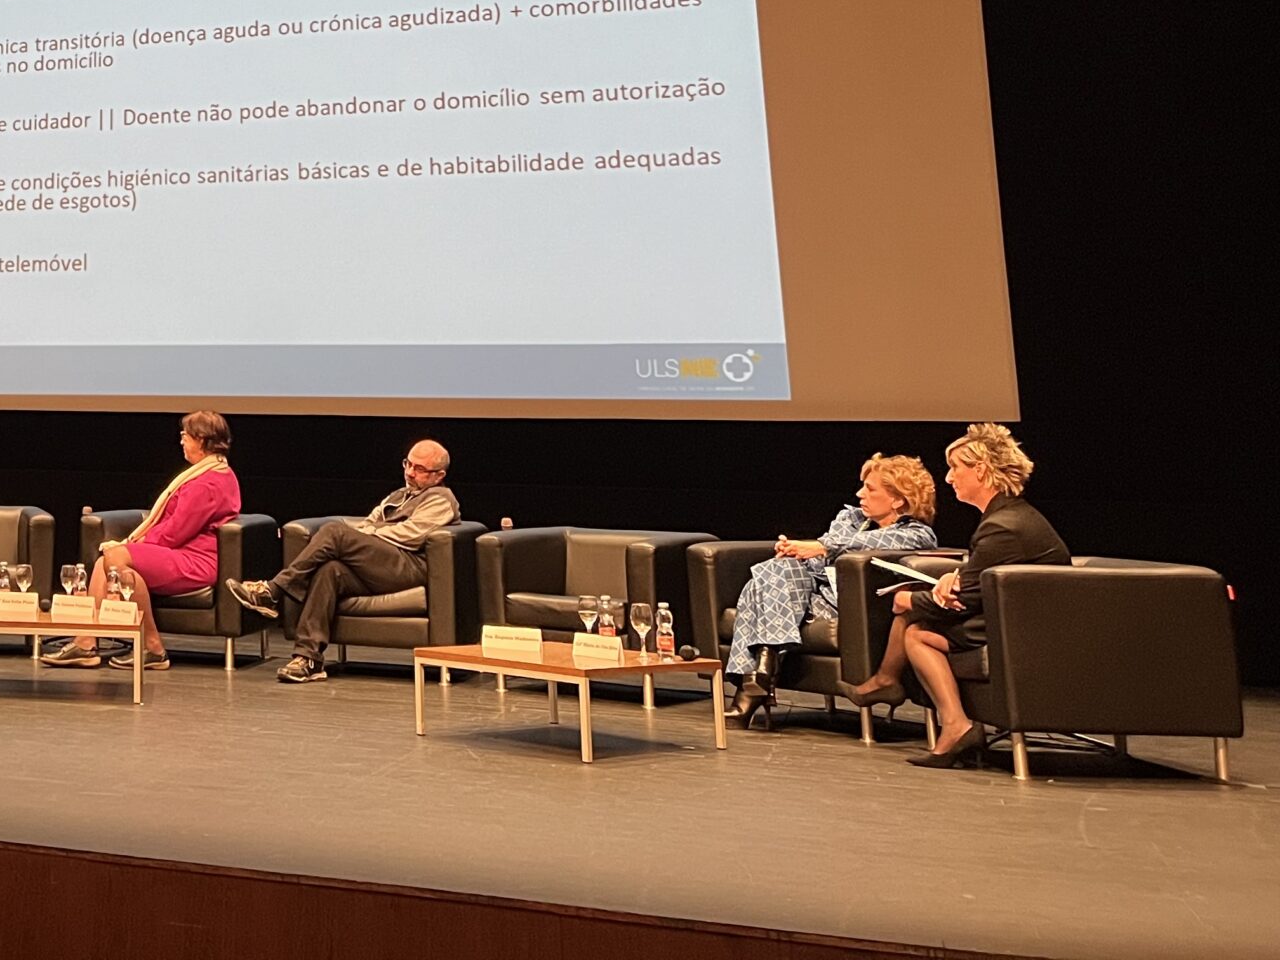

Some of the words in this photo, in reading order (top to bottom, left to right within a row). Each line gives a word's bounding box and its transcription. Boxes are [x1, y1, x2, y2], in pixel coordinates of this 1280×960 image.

[34, 31, 125, 53] transitória
[132, 27, 207, 50] (doença
[212, 19, 271, 44] aguda
[277, 21, 303, 36] ou
[309, 13, 382, 33] crónica
[388, 2, 501, 32] agudizada)
[6, 60, 29, 74] no
[33, 50, 114, 72] domicílio
[12, 111, 92, 132] cuidador
[123, 108, 192, 126] Doente
[197, 103, 233, 123] não
[239, 100, 290, 125] pode
[295, 95, 407, 118] abandonar
[413, 97, 427, 112] o
[432, 87, 530, 111] domicílio
[539, 89, 585, 105] sem
[592, 77, 726, 103] autorização
[10, 171, 102, 194] condições
[107, 168, 191, 192] higiénico
[197, 164, 289, 184] sanitárias
[298, 161, 370, 181] básicas
[377, 163, 390, 178] e
[396, 157, 423, 177] de
[429, 151, 585, 176] habitabilidade
[594, 146, 722, 173] adequadas
[31, 192, 55, 211] de
[59, 191, 137, 214] esgotos)
